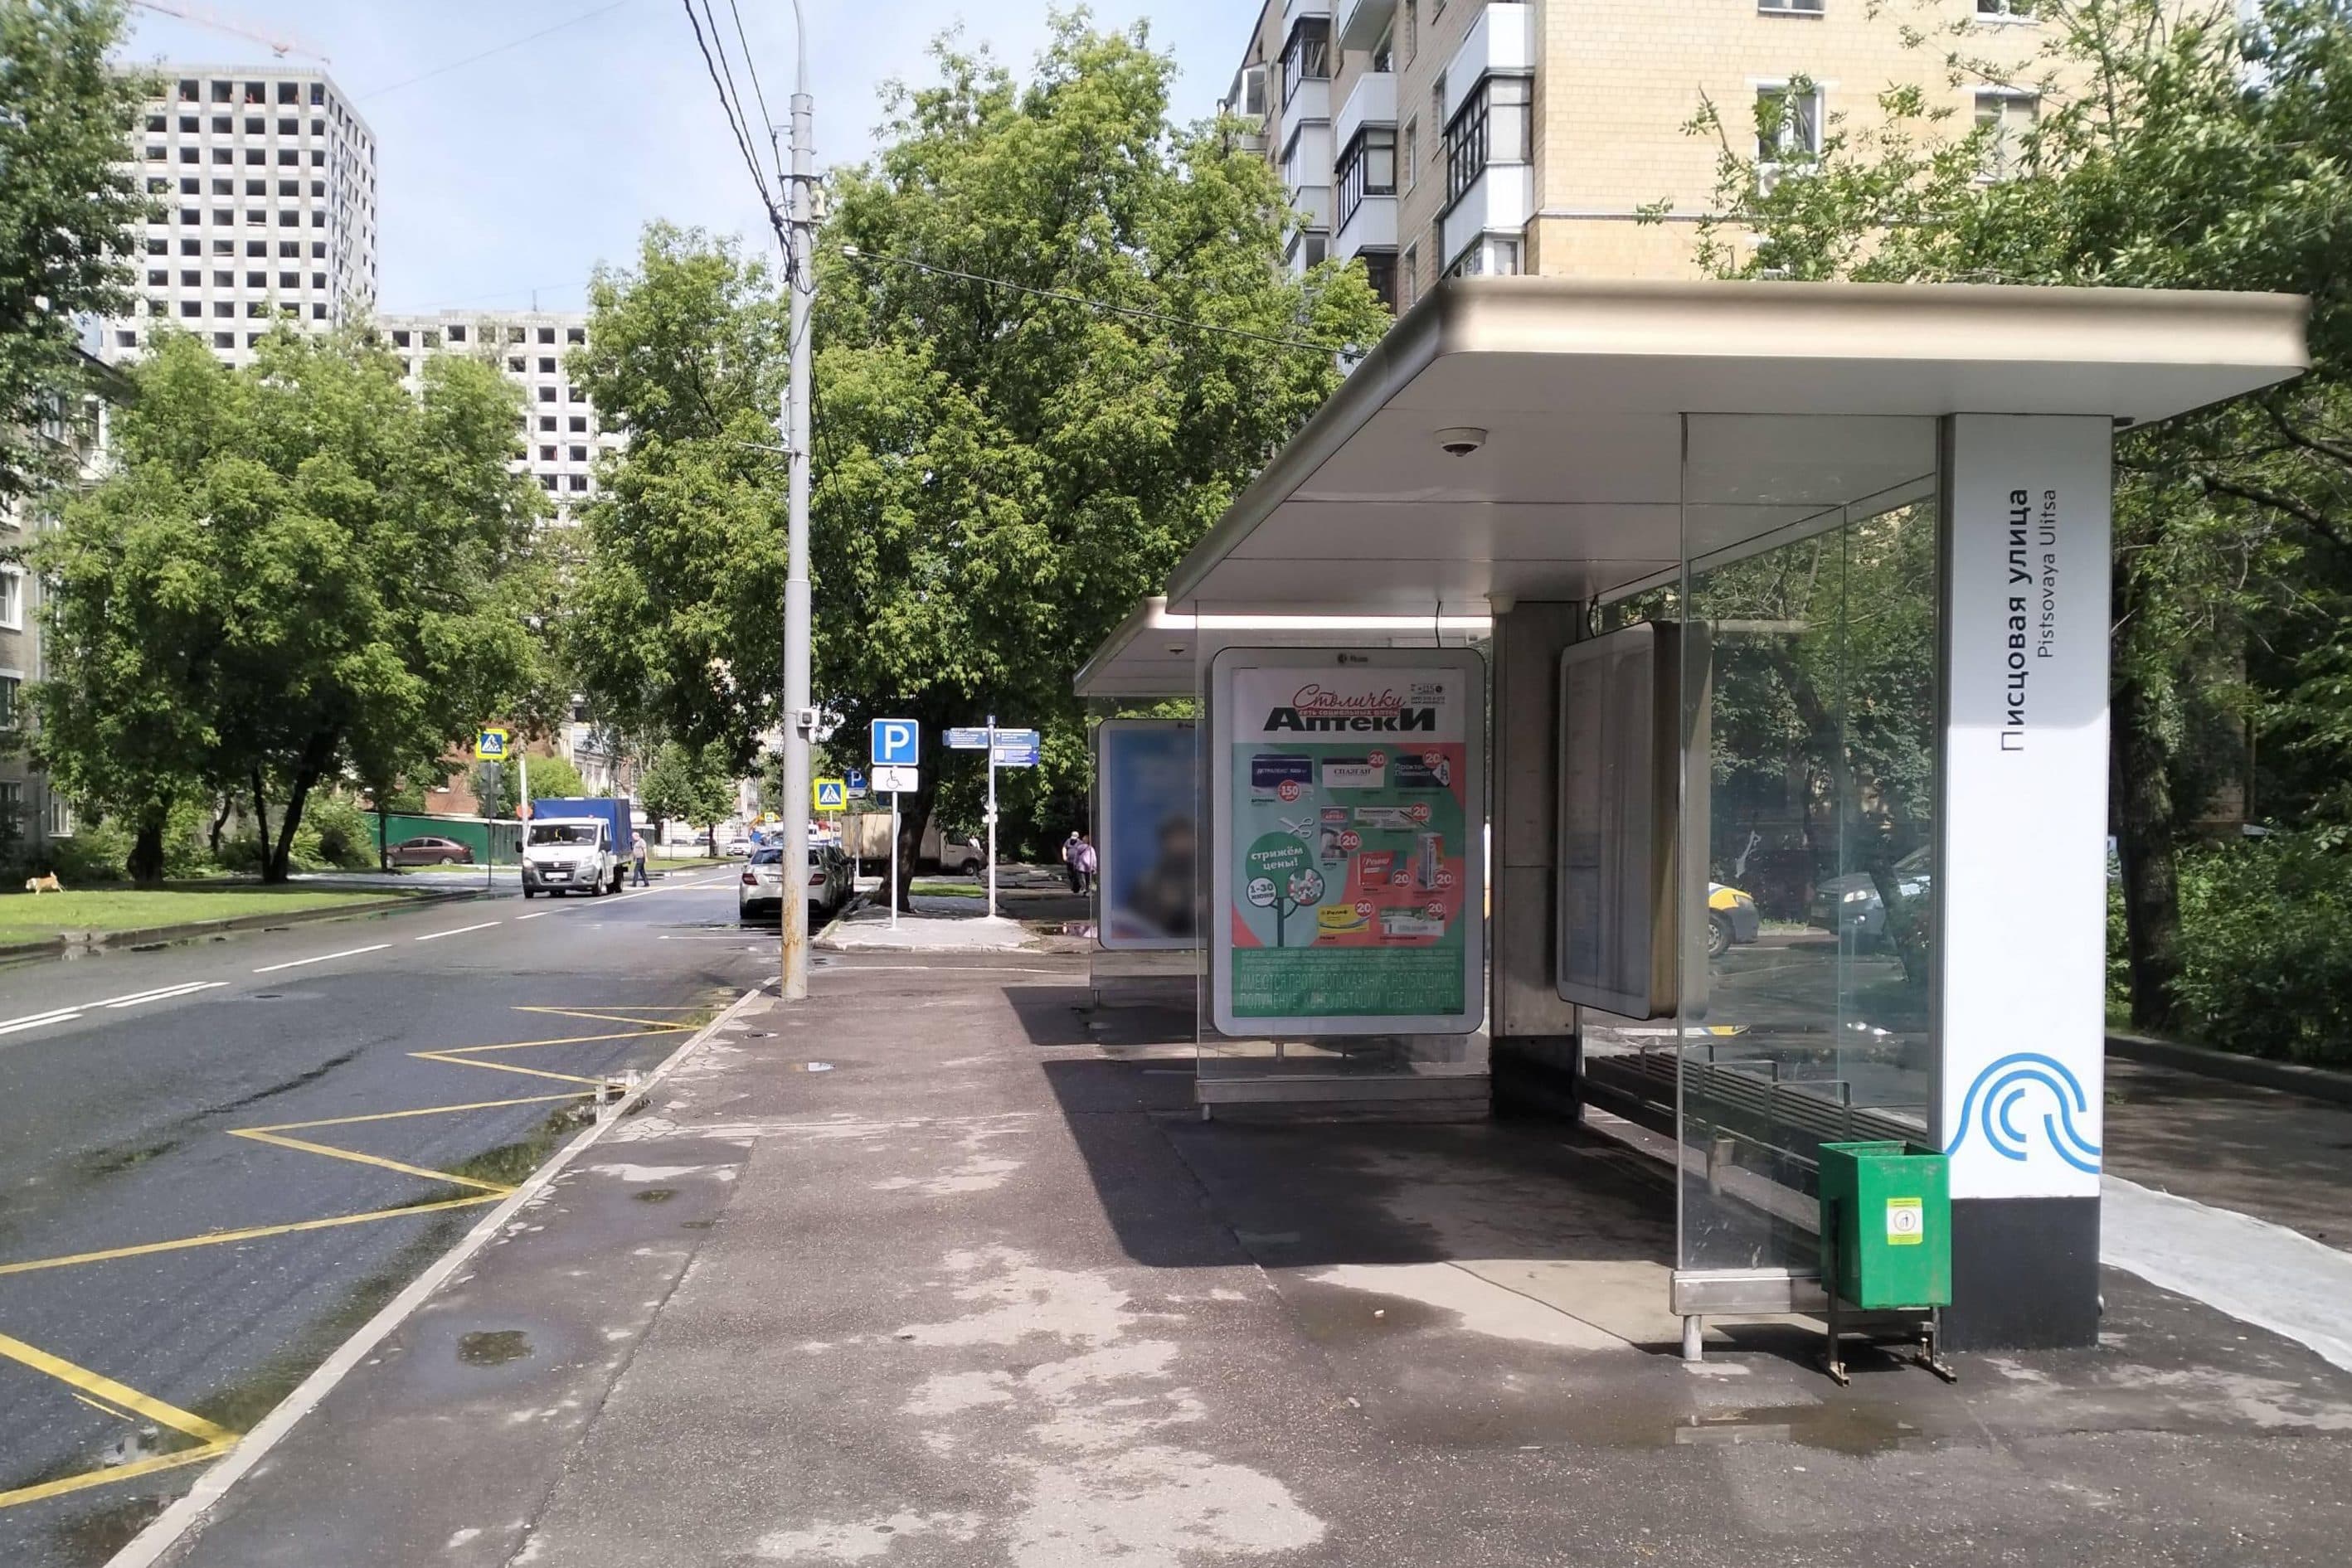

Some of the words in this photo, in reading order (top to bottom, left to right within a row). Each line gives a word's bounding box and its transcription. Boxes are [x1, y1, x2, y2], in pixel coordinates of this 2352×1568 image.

[2039, 489, 2057, 546] Ulitsa
[2009, 489, 2033, 585] улица
[2038, 553, 2058, 658] Pistsovaya
[2000, 596, 2029, 751] Писцовая
[1292, 683, 1407, 709] Столички
[885, 725, 910, 760] P
[851, 771, 862, 787] P
[1251, 846, 1304, 861] стрижём
[1263, 857, 1298, 870] цены!
